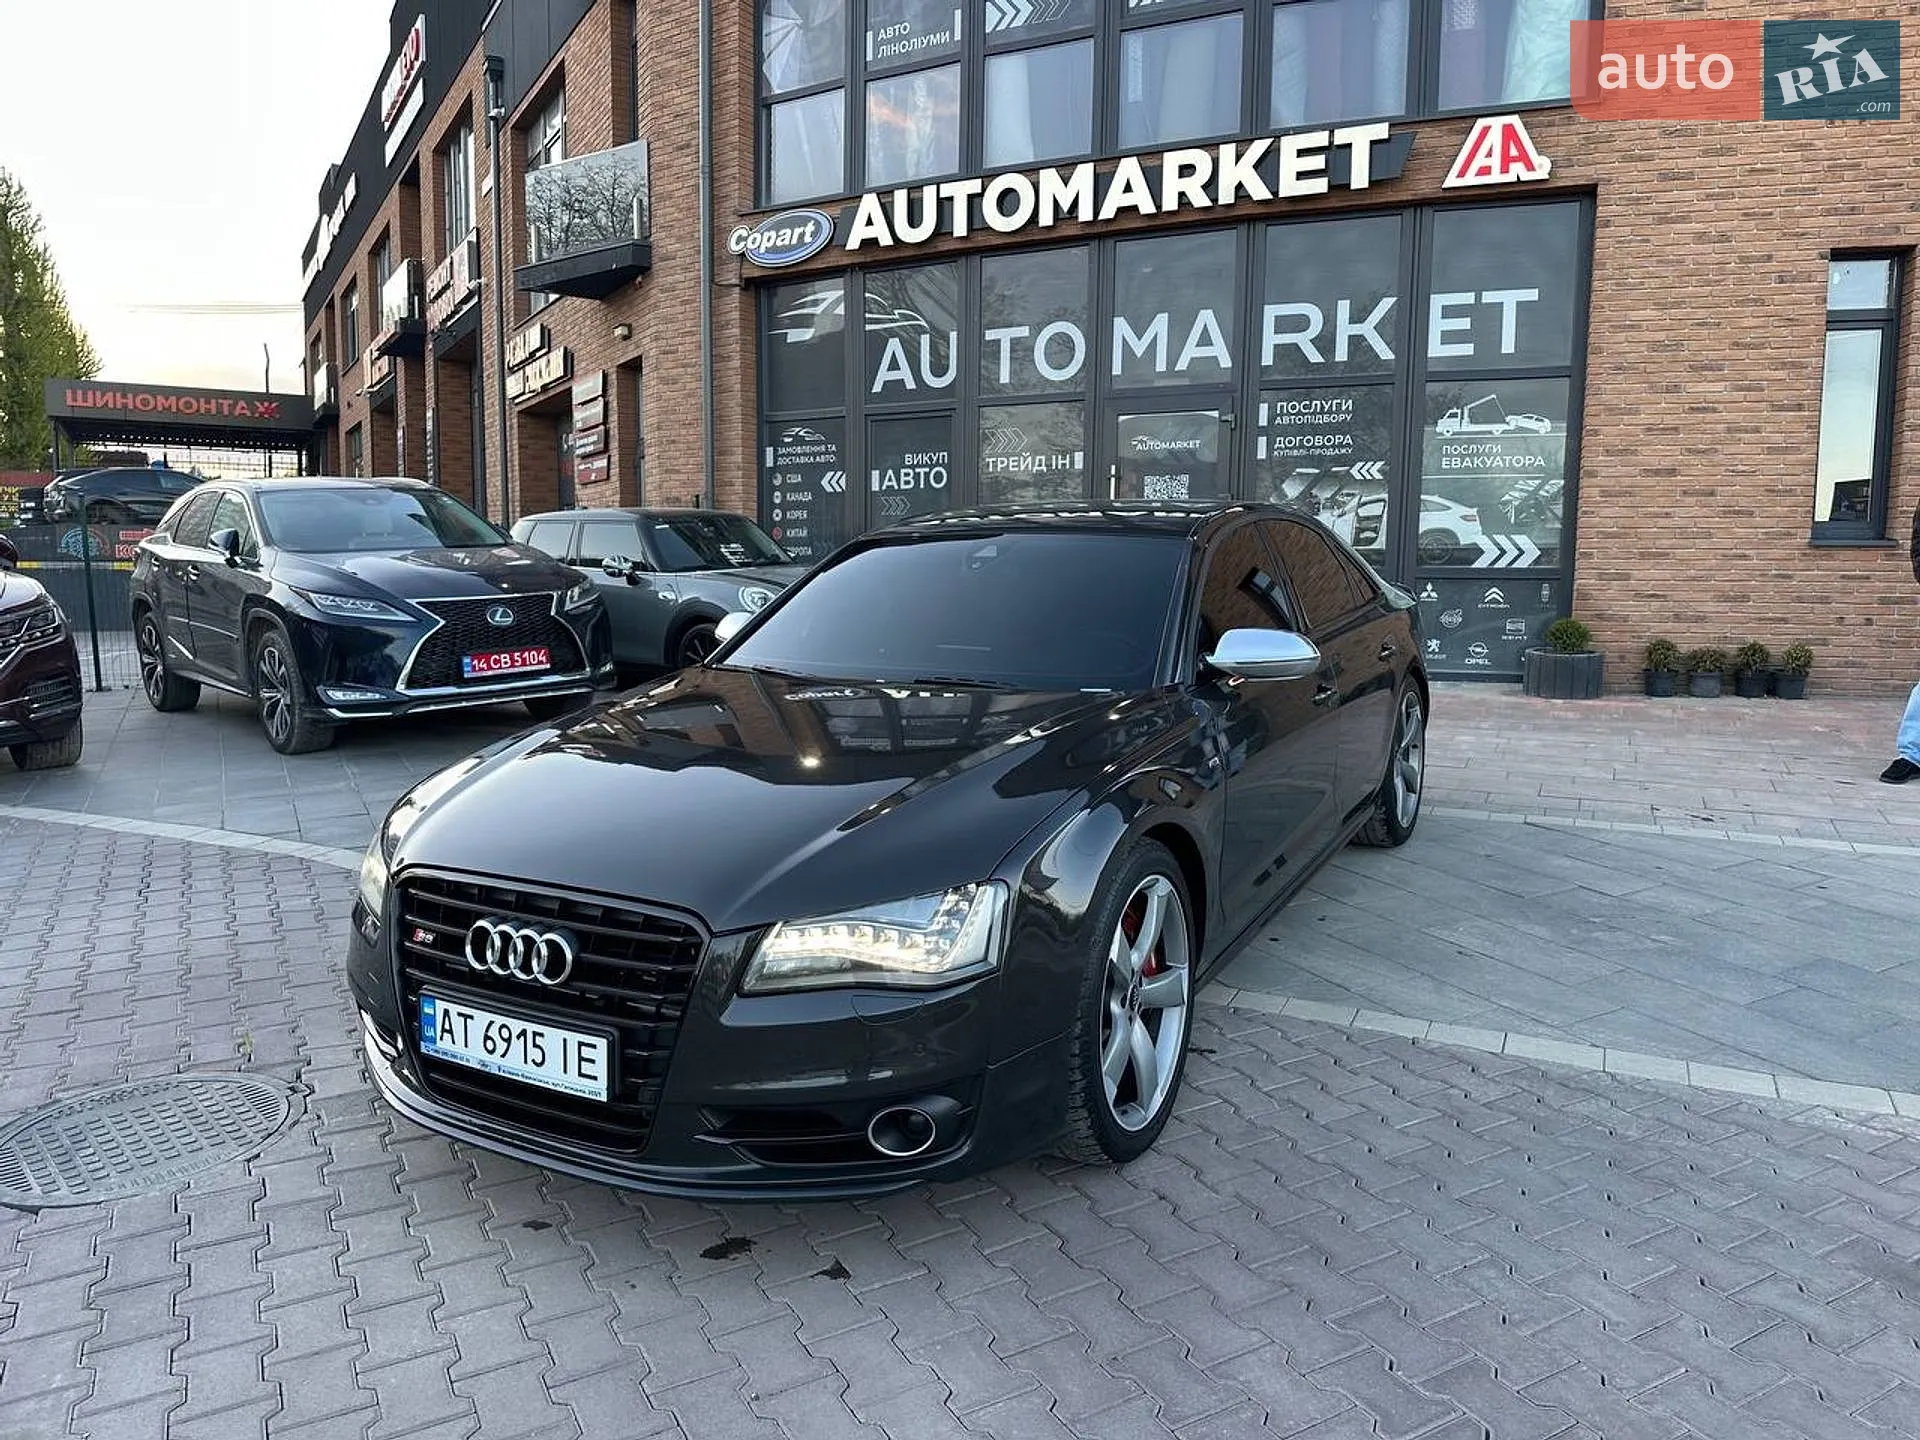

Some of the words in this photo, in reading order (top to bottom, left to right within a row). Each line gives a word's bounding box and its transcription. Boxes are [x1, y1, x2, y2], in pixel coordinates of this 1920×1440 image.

[878, 22, 910, 41] АВТО
[878, 30, 950, 58] ЛІНОЛІУМИ
[845, 122, 1390, 251] AUTOMARKET
[729, 219, 816, 254] Copart
[65, 388, 281, 418] ШИНОМОНТАЖ
[1276, 399, 1353, 414] ПОСЛУГИ
[1274, 413, 1353, 425] АВТОПІДБОРУ
[1135, 439, 1201, 451] AUTOMARKET
[1274, 434, 1354, 449] ДОГОВОРА
[1442, 444, 1502, 455] ПОСЛУГИ
[777, 456, 814, 466] ДОСТАВКА
[815, 454, 836, 463] АВТО
[904, 452, 948, 465] ВИКУП
[986, 452, 1047, 474] ТРЕЙД
[1052, 454, 1070, 469] ІН
[1441, 455, 1546, 469] ЕВАКУАТОРА
[786, 473, 802, 483] США
[881, 466, 948, 490] АВТО
[472, 658, 487, 671] 14
[490, 654, 511, 669] CB
[514, 649, 547, 666] 5104
[439, 1007, 475, 1048] AT
[483, 1020, 546, 1068] 6915
[562, 1037, 598, 1081] IE
